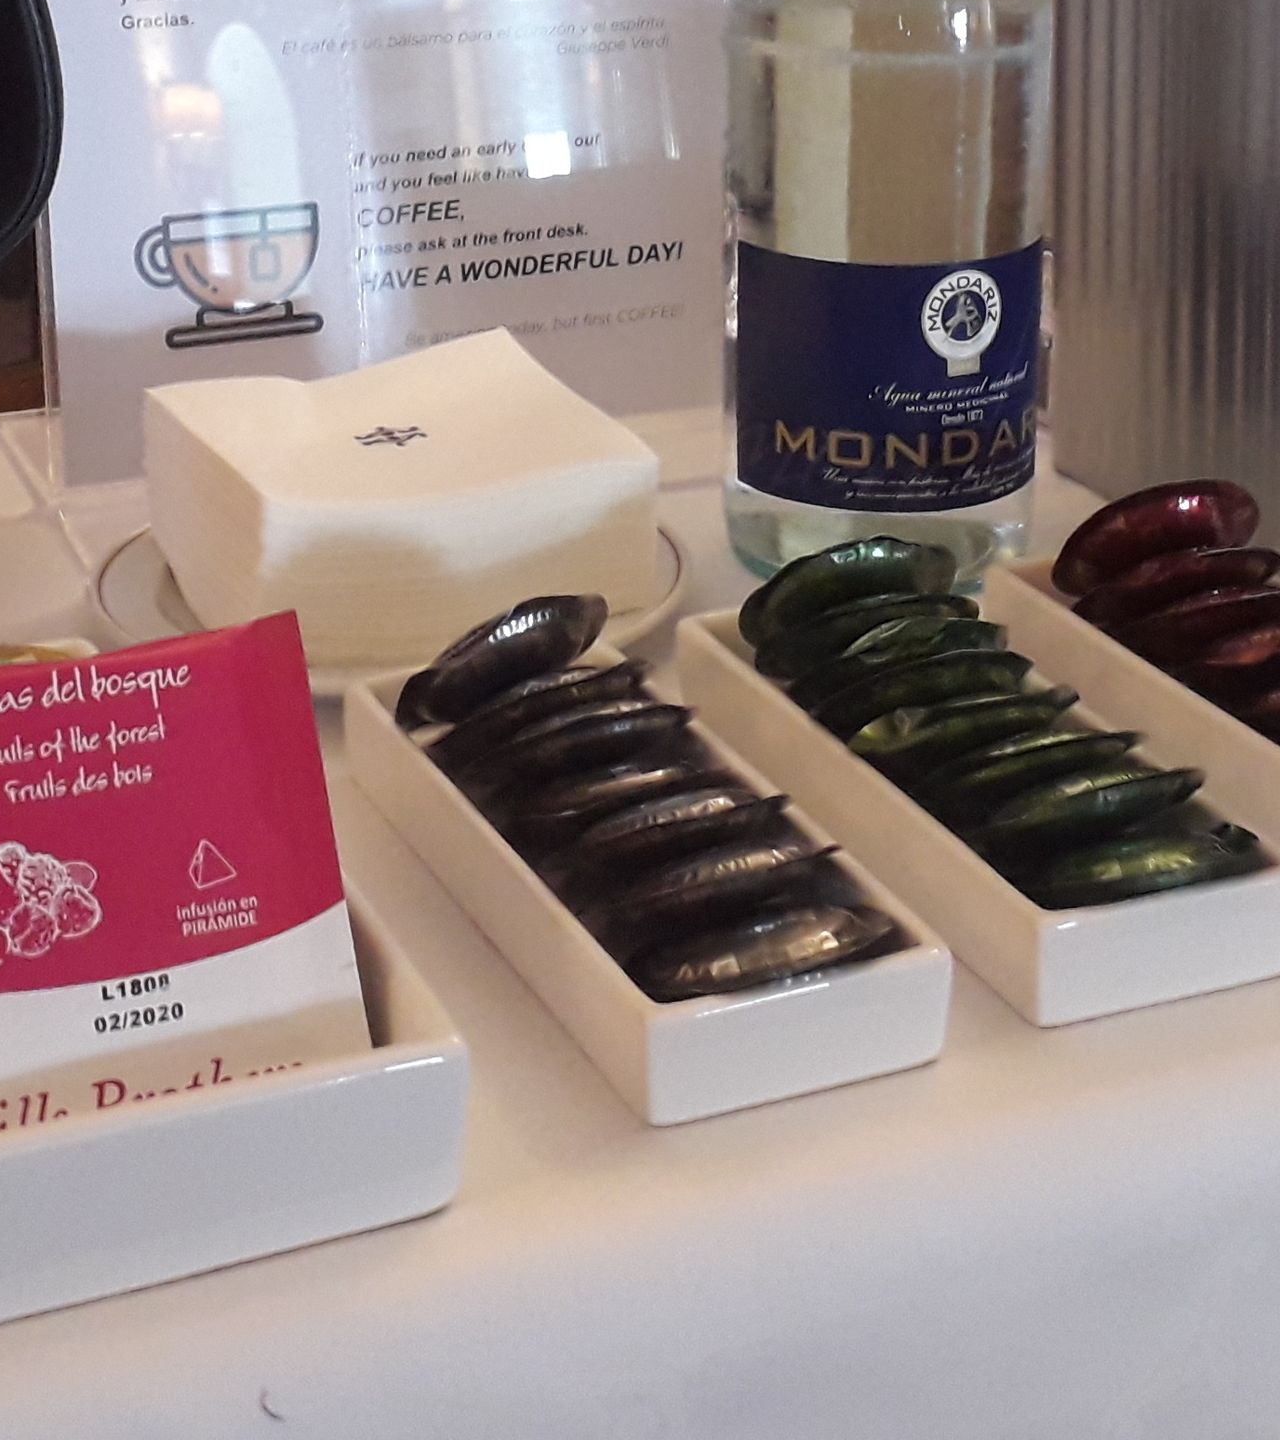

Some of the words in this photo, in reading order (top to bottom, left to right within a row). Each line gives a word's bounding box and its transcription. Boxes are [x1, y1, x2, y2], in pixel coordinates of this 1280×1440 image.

[121, 11, 194, 30] Gracias.
[631, 34, 669, 50] Verdi
[370, 152, 400, 169] you
[406, 145, 447, 162] need
[451, 144, 470, 159] an
[477, 137, 516, 157] early
[392, 176, 422, 192] you
[428, 170, 458, 186] feel
[463, 169, 491, 184] like
[357, 199, 464, 228] COFFEE,
[418, 236, 447, 252] ask
[452, 234, 467, 249] at
[473, 231, 497, 246] the
[503, 225, 541, 244] front
[547, 222, 588, 240] desk.
[360, 266, 429, 292] HAVE
[434, 263, 452, 286] A
[460, 247, 619, 284] WONDERFUL
[627, 241, 683, 266] DAY!
[927, 275, 998, 332] MONDARIZ
[868, 382, 921, 408] Agua
[927, 376, 988, 401] mineral
[989, 361, 1028, 391] natural
[905, 402, 953, 413] MINERO
[41, 677, 84, 710] del
[91, 664, 193, 709] bosque
[40, 730, 66, 764] of
[69, 724, 101, 752] the
[107, 713, 167, 749] forest
[4, 773, 67, 805] Fruits
[73, 767, 110, 797] des
[113, 762, 154, 788] bois
[240, 895, 259, 910] en
[94, 1002, 184, 1033] 02/2020
